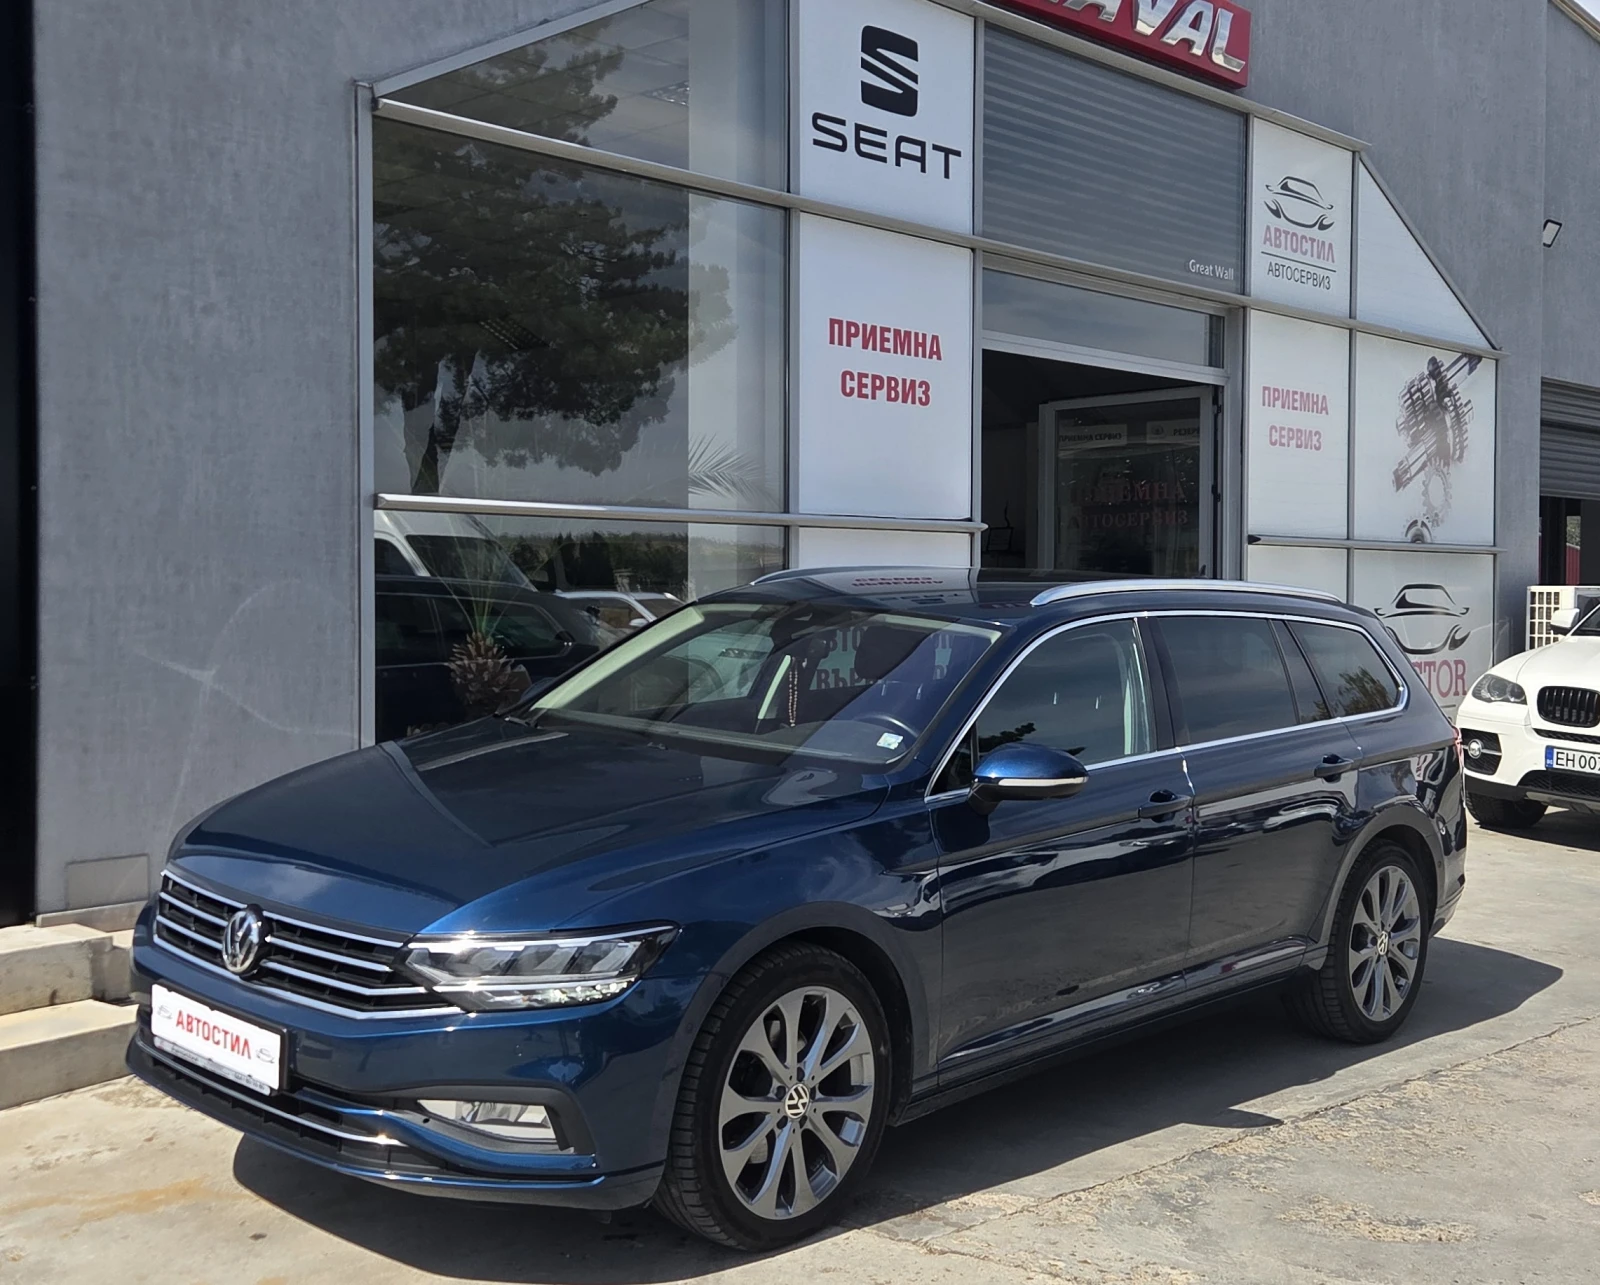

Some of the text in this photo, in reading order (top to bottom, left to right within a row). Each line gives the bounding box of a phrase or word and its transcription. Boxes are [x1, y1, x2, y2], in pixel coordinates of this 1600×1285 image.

[811, 112, 962, 179] SEAT
[1263, 225, 1335, 264] АВТОСТИЛ
[1189, 259, 1235, 280] Great Wall
[1267, 261, 1332, 290] АВТОСЕРВИЗ
[828, 318, 942, 361] ПРИЕМНА
[840, 370, 931, 407] СЕРВИЗ
[1262, 386, 1329, 415] ПРИЕМНА
[1269, 425, 1322, 451] СЕРВИЗ
[176, 1010, 251, 1060] АВТОСТИЛ
